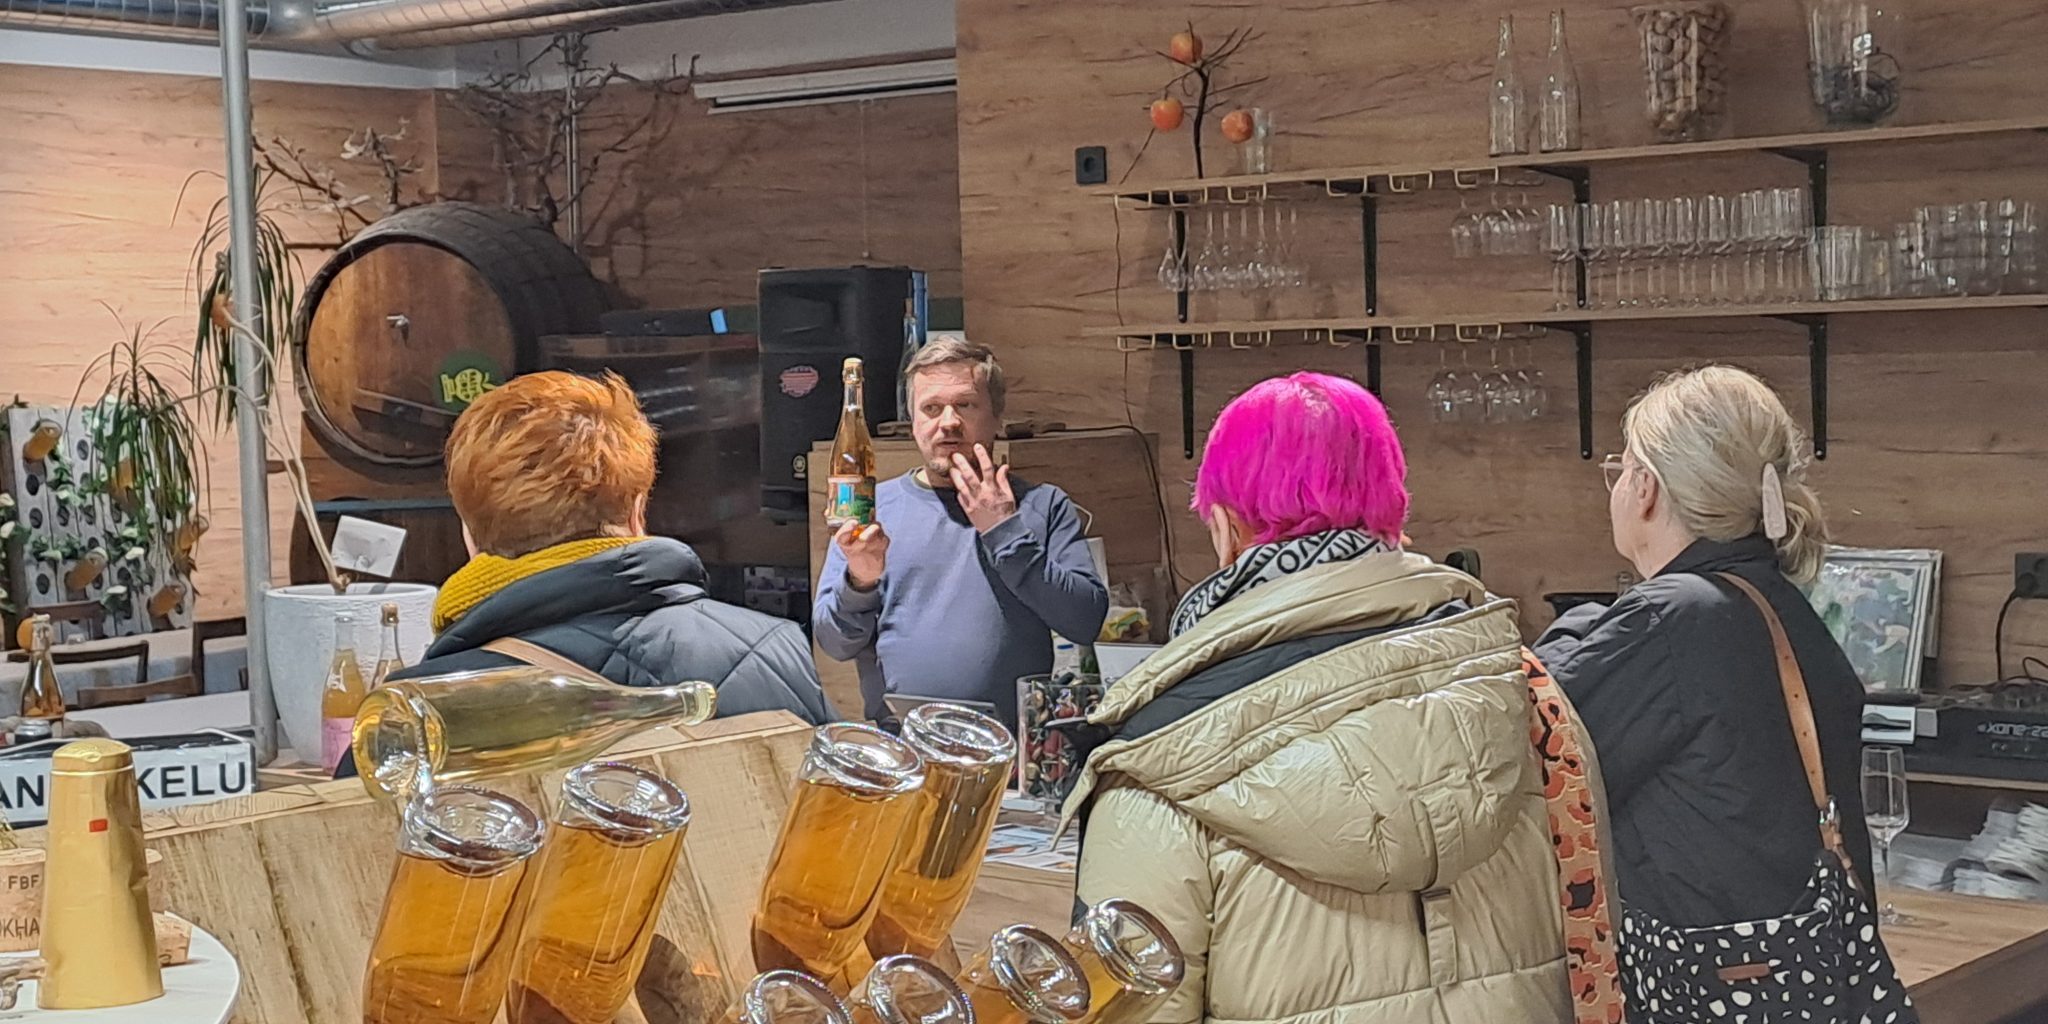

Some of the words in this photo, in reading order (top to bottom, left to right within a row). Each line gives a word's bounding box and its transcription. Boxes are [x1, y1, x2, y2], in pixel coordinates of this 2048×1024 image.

[136, 761, 246, 800] KELU
[8, 874, 39, 890] FBF
[0, 917, 40, 938] KHA
